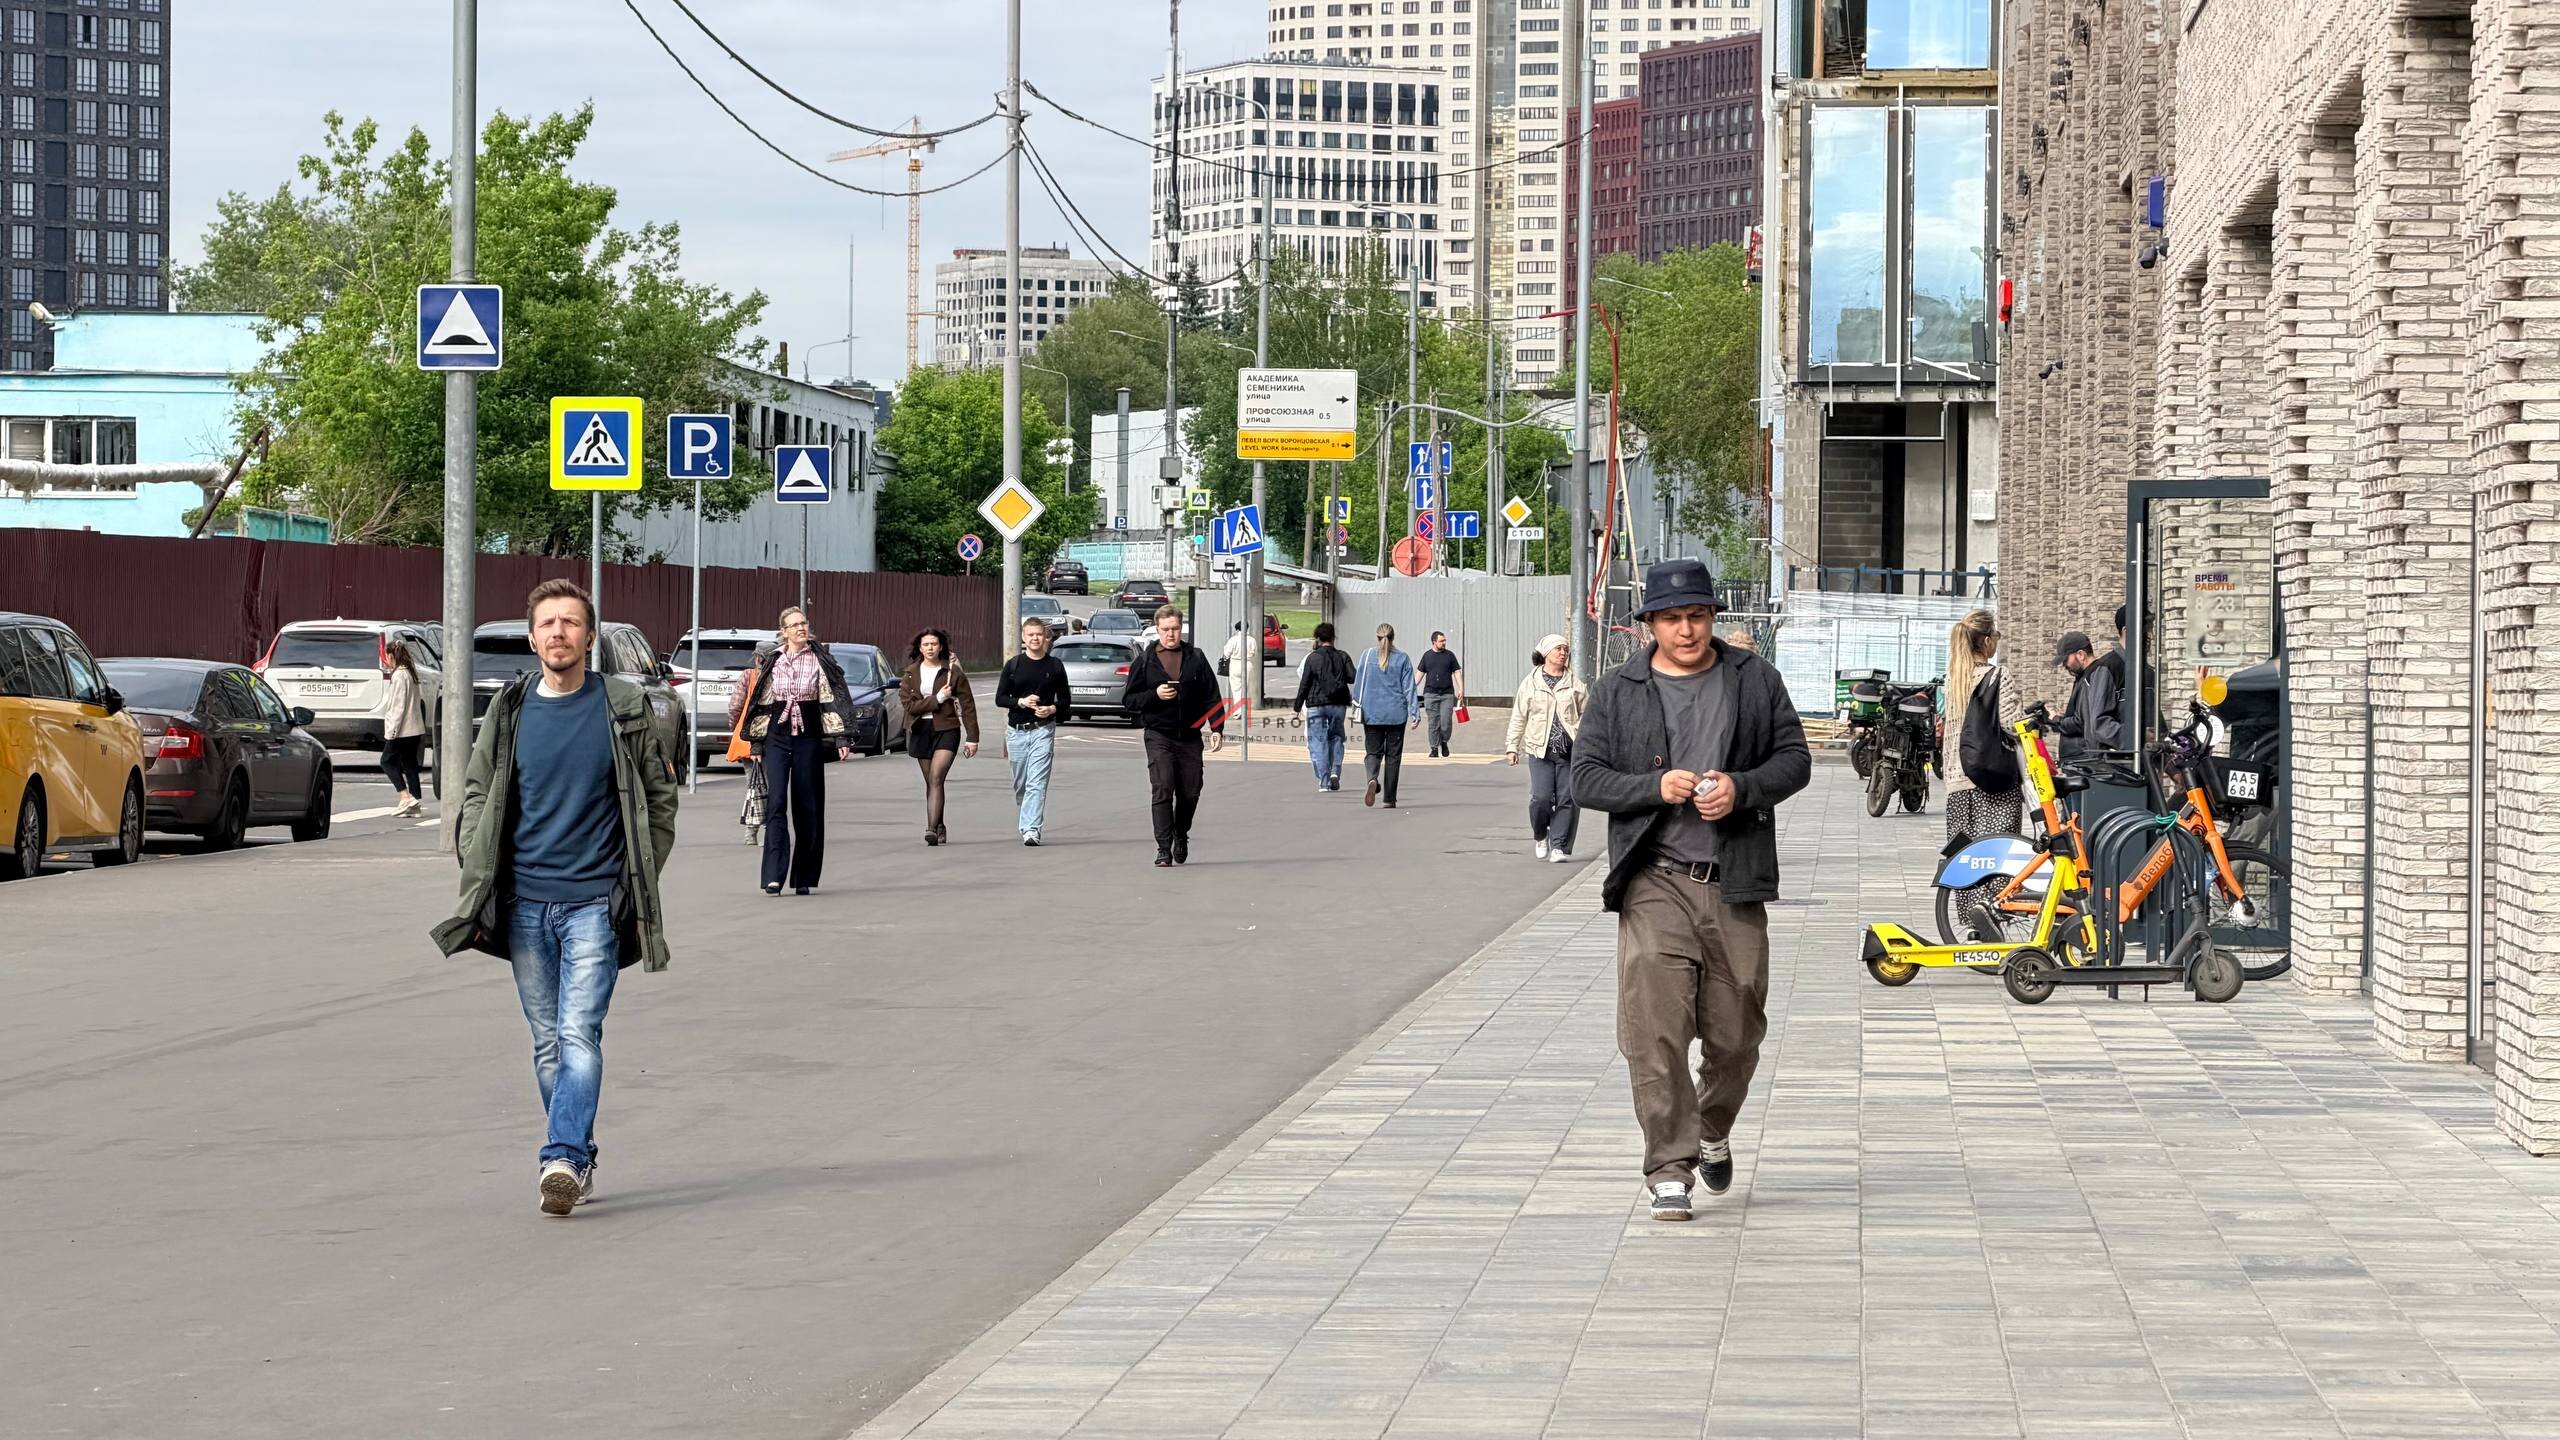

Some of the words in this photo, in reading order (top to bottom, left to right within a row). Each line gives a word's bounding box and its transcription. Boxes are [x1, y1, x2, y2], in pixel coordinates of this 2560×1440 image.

[1246, 375, 1299, 383] АКАДЕМИКА
[1246, 384, 1305, 392] СЕМЕНИХИНА
[1246, 407, 1315, 416] ПРОФСОЮЗНАЯ
[1246, 416, 1271, 424] улица
[1319, 412, 1331, 420] 0.5
[684, 422, 718, 470] P
[2195, 574, 2228, 582] ВРЕМЯ
[2195, 583, 2235, 591] РАБОТЫ
[2230, 772, 2257, 785] AA5
[2230, 784, 2256, 797] 68A
[1971, 857, 1996, 870] ВТБ
[2141, 846, 2172, 883] Велоб
